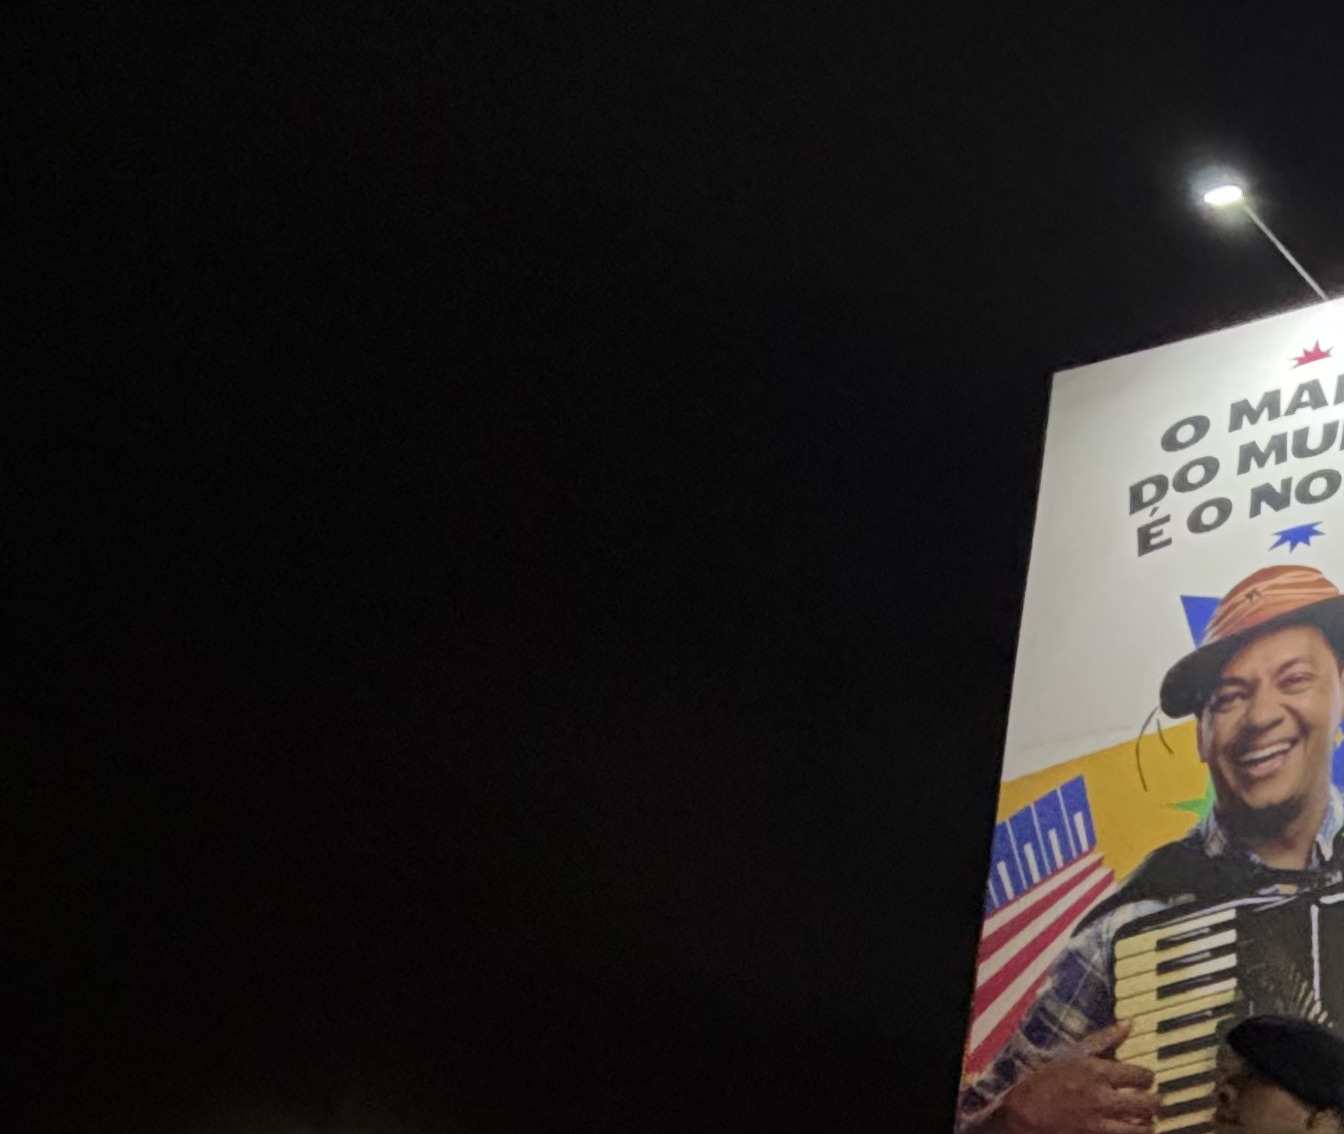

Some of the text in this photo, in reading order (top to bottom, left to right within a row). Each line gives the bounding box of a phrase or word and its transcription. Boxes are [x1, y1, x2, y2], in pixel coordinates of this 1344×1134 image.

[1160, 414, 1211, 453] O
[1129, 455, 1220, 516] DO
[1137, 505, 1173, 558] É
[1187, 496, 1233, 534] O
